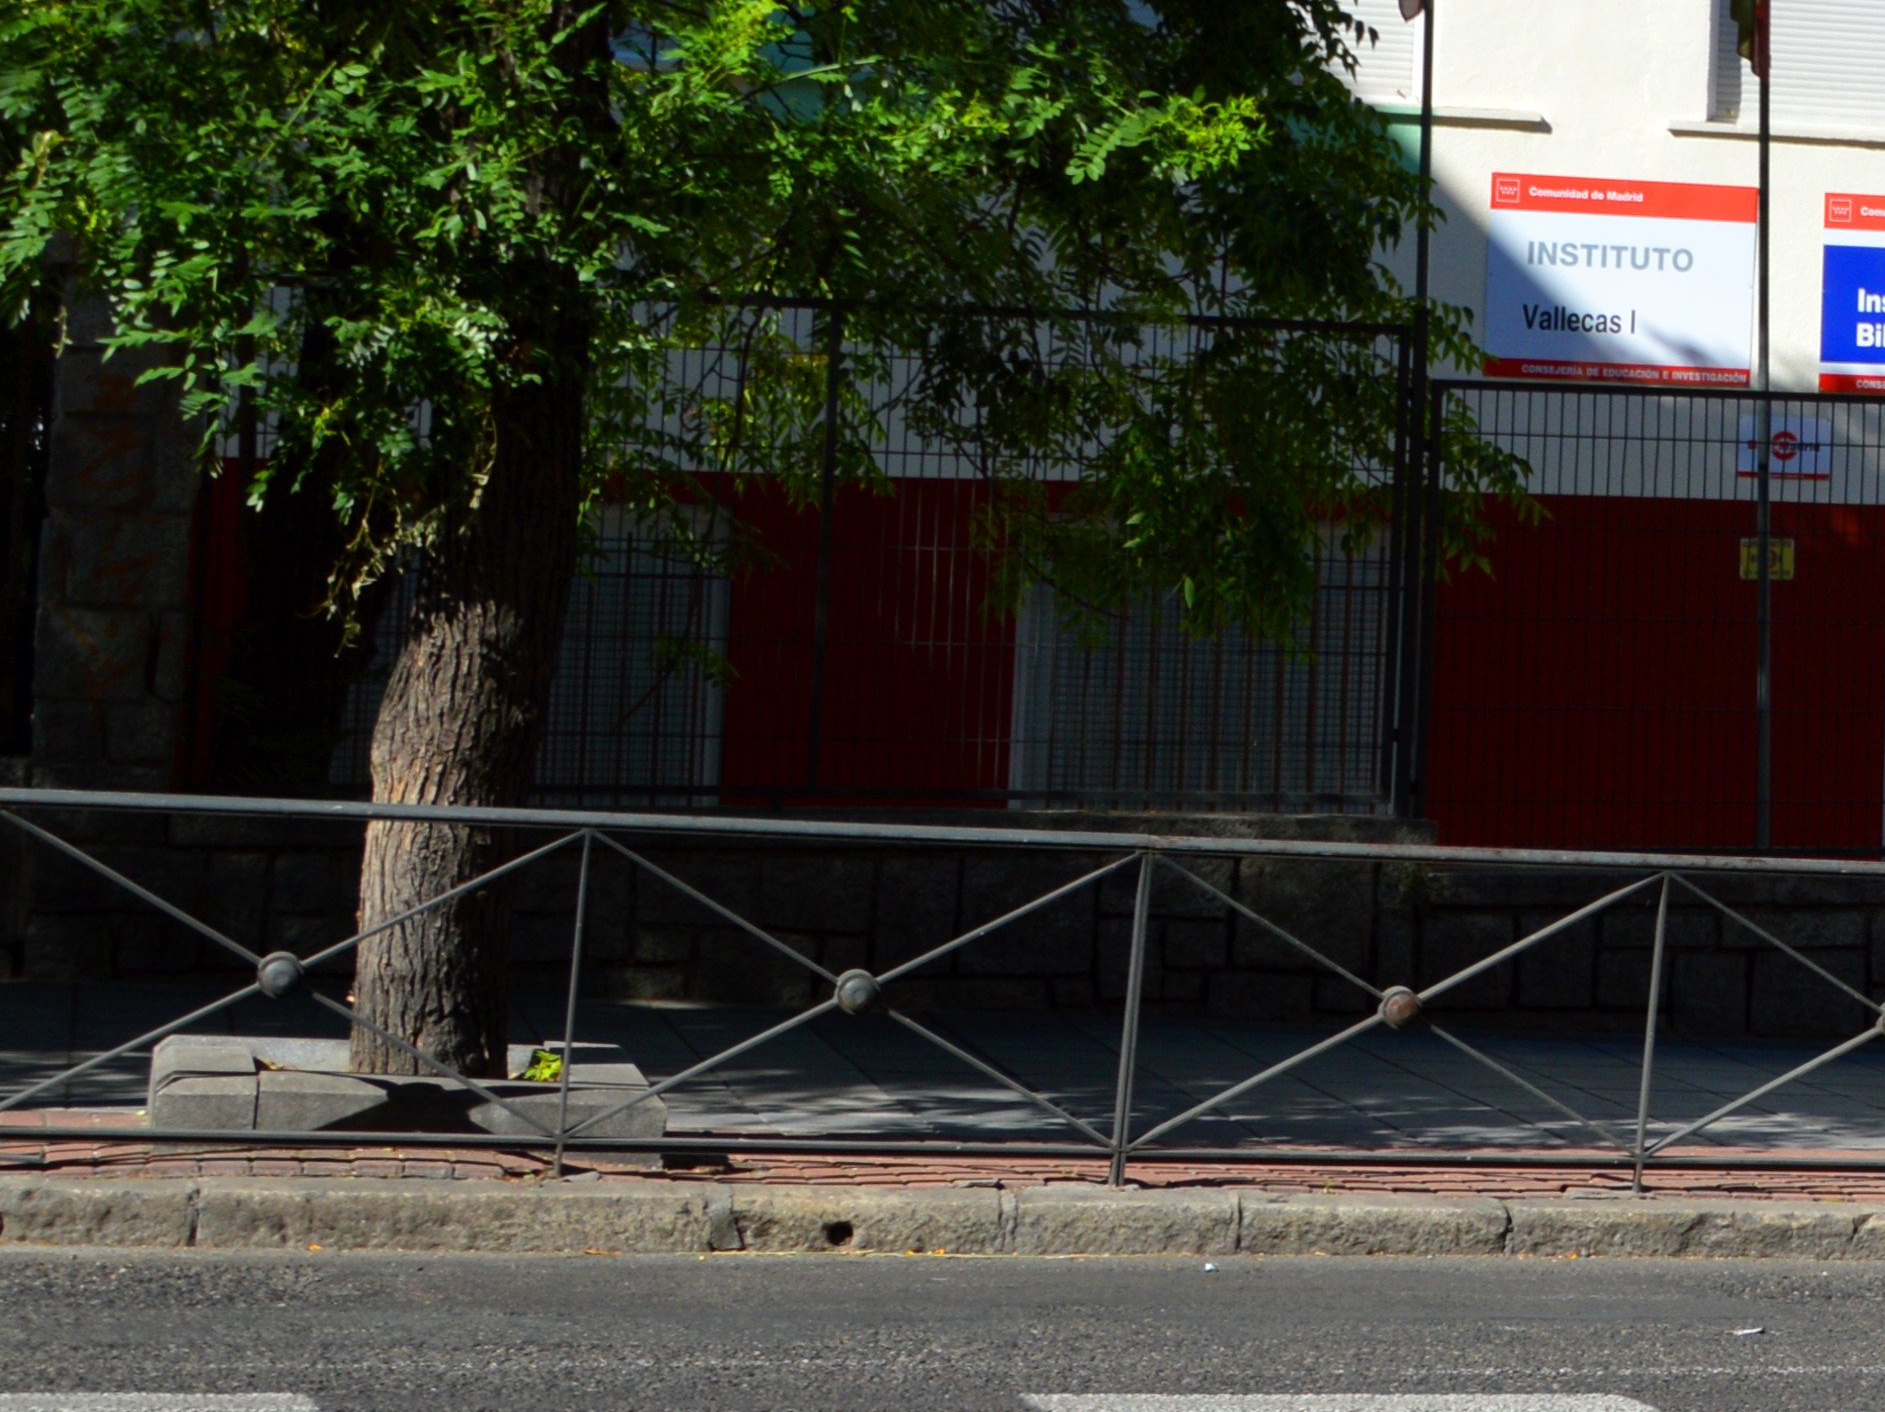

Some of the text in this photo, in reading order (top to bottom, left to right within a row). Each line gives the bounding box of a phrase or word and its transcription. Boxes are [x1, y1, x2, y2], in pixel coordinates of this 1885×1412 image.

[1529, 186, 1643, 202] Comunidad de Madrid
[1527, 241, 1693, 272] INSTITUTO
[1522, 304, 1636, 334] Vallecas I
[1521, 364, 1747, 383] CONSEJERÍA DE EDUCACIÓN E INVESTIGACIÓN
